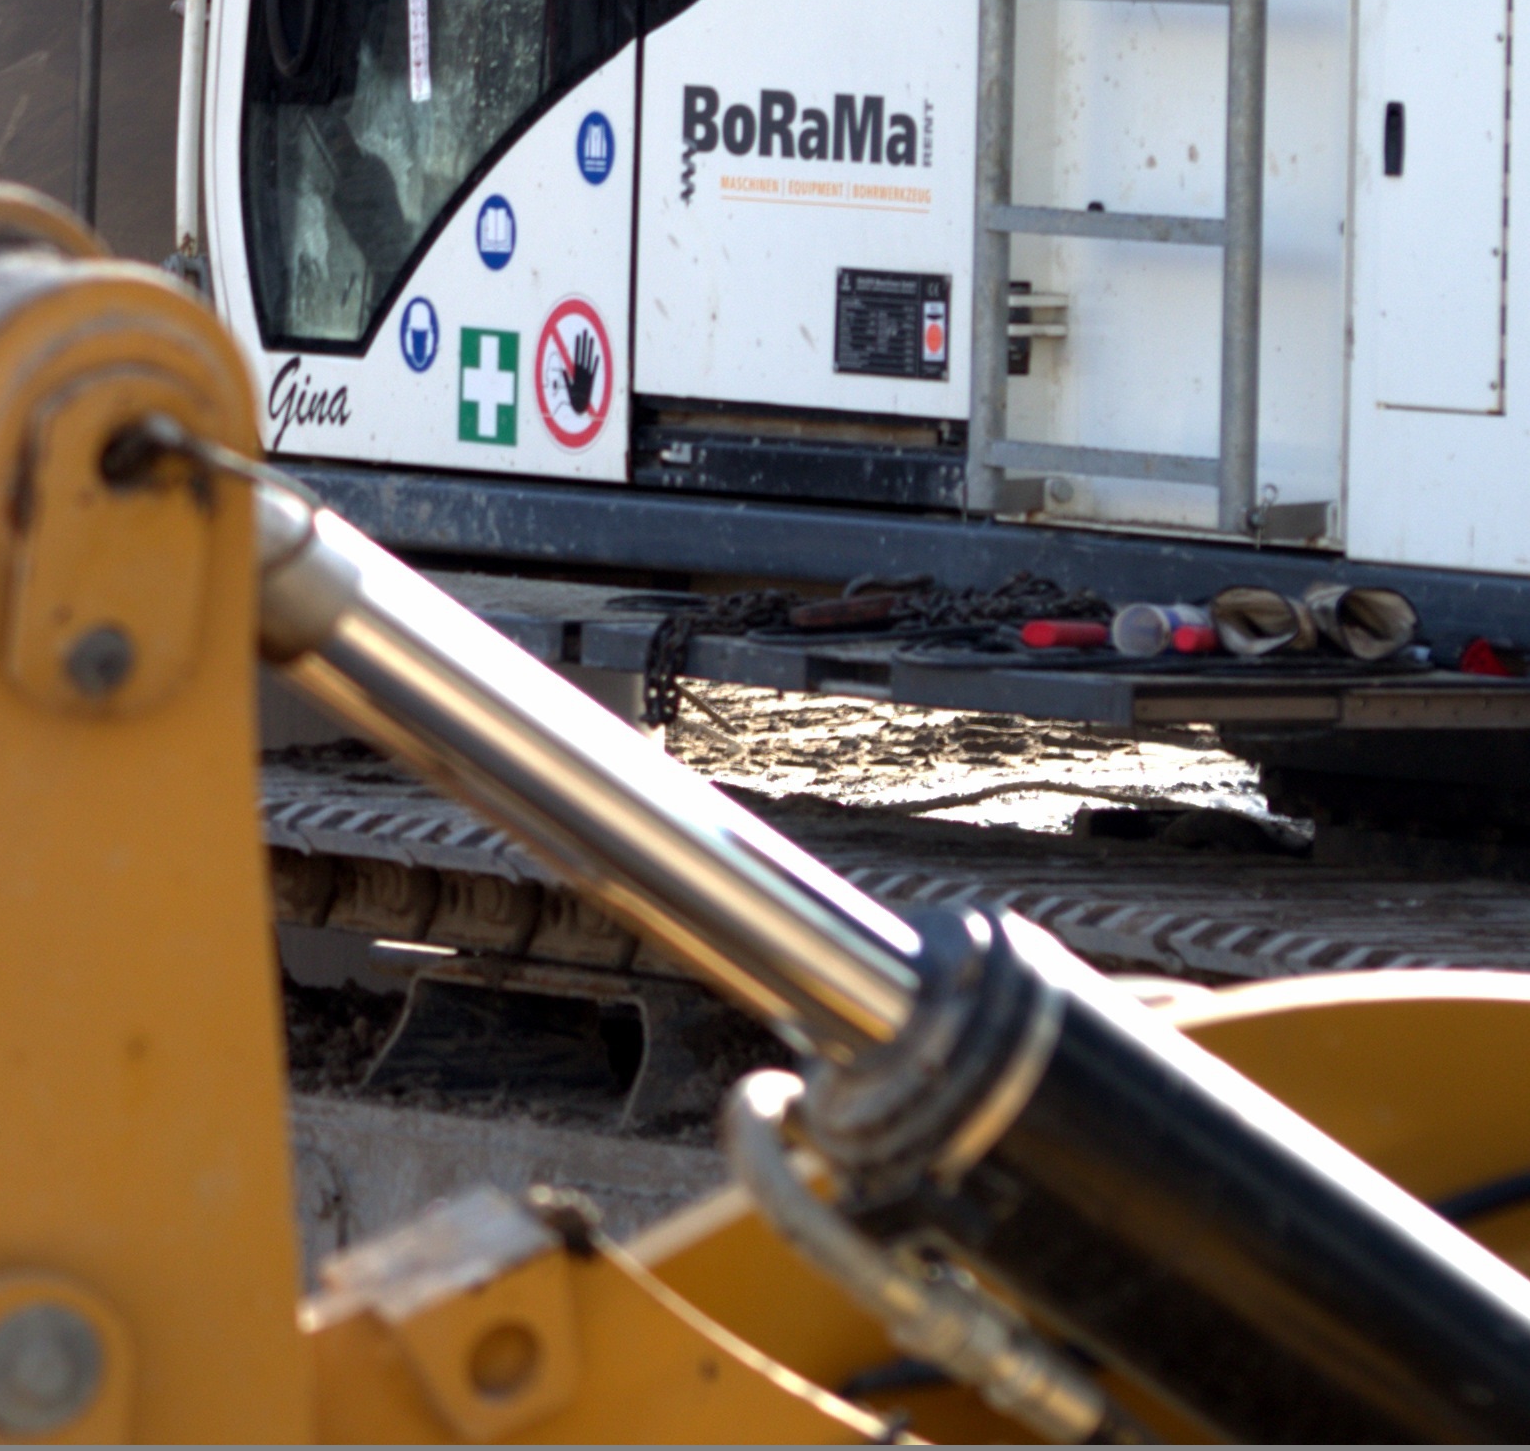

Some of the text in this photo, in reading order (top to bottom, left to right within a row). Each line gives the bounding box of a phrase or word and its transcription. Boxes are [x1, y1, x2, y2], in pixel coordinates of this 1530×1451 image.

[682, 84, 934, 167] BoRaMa RENT
[788, 180, 844, 197] EQUIPMENT
[268, 354, 352, 453] Gina
